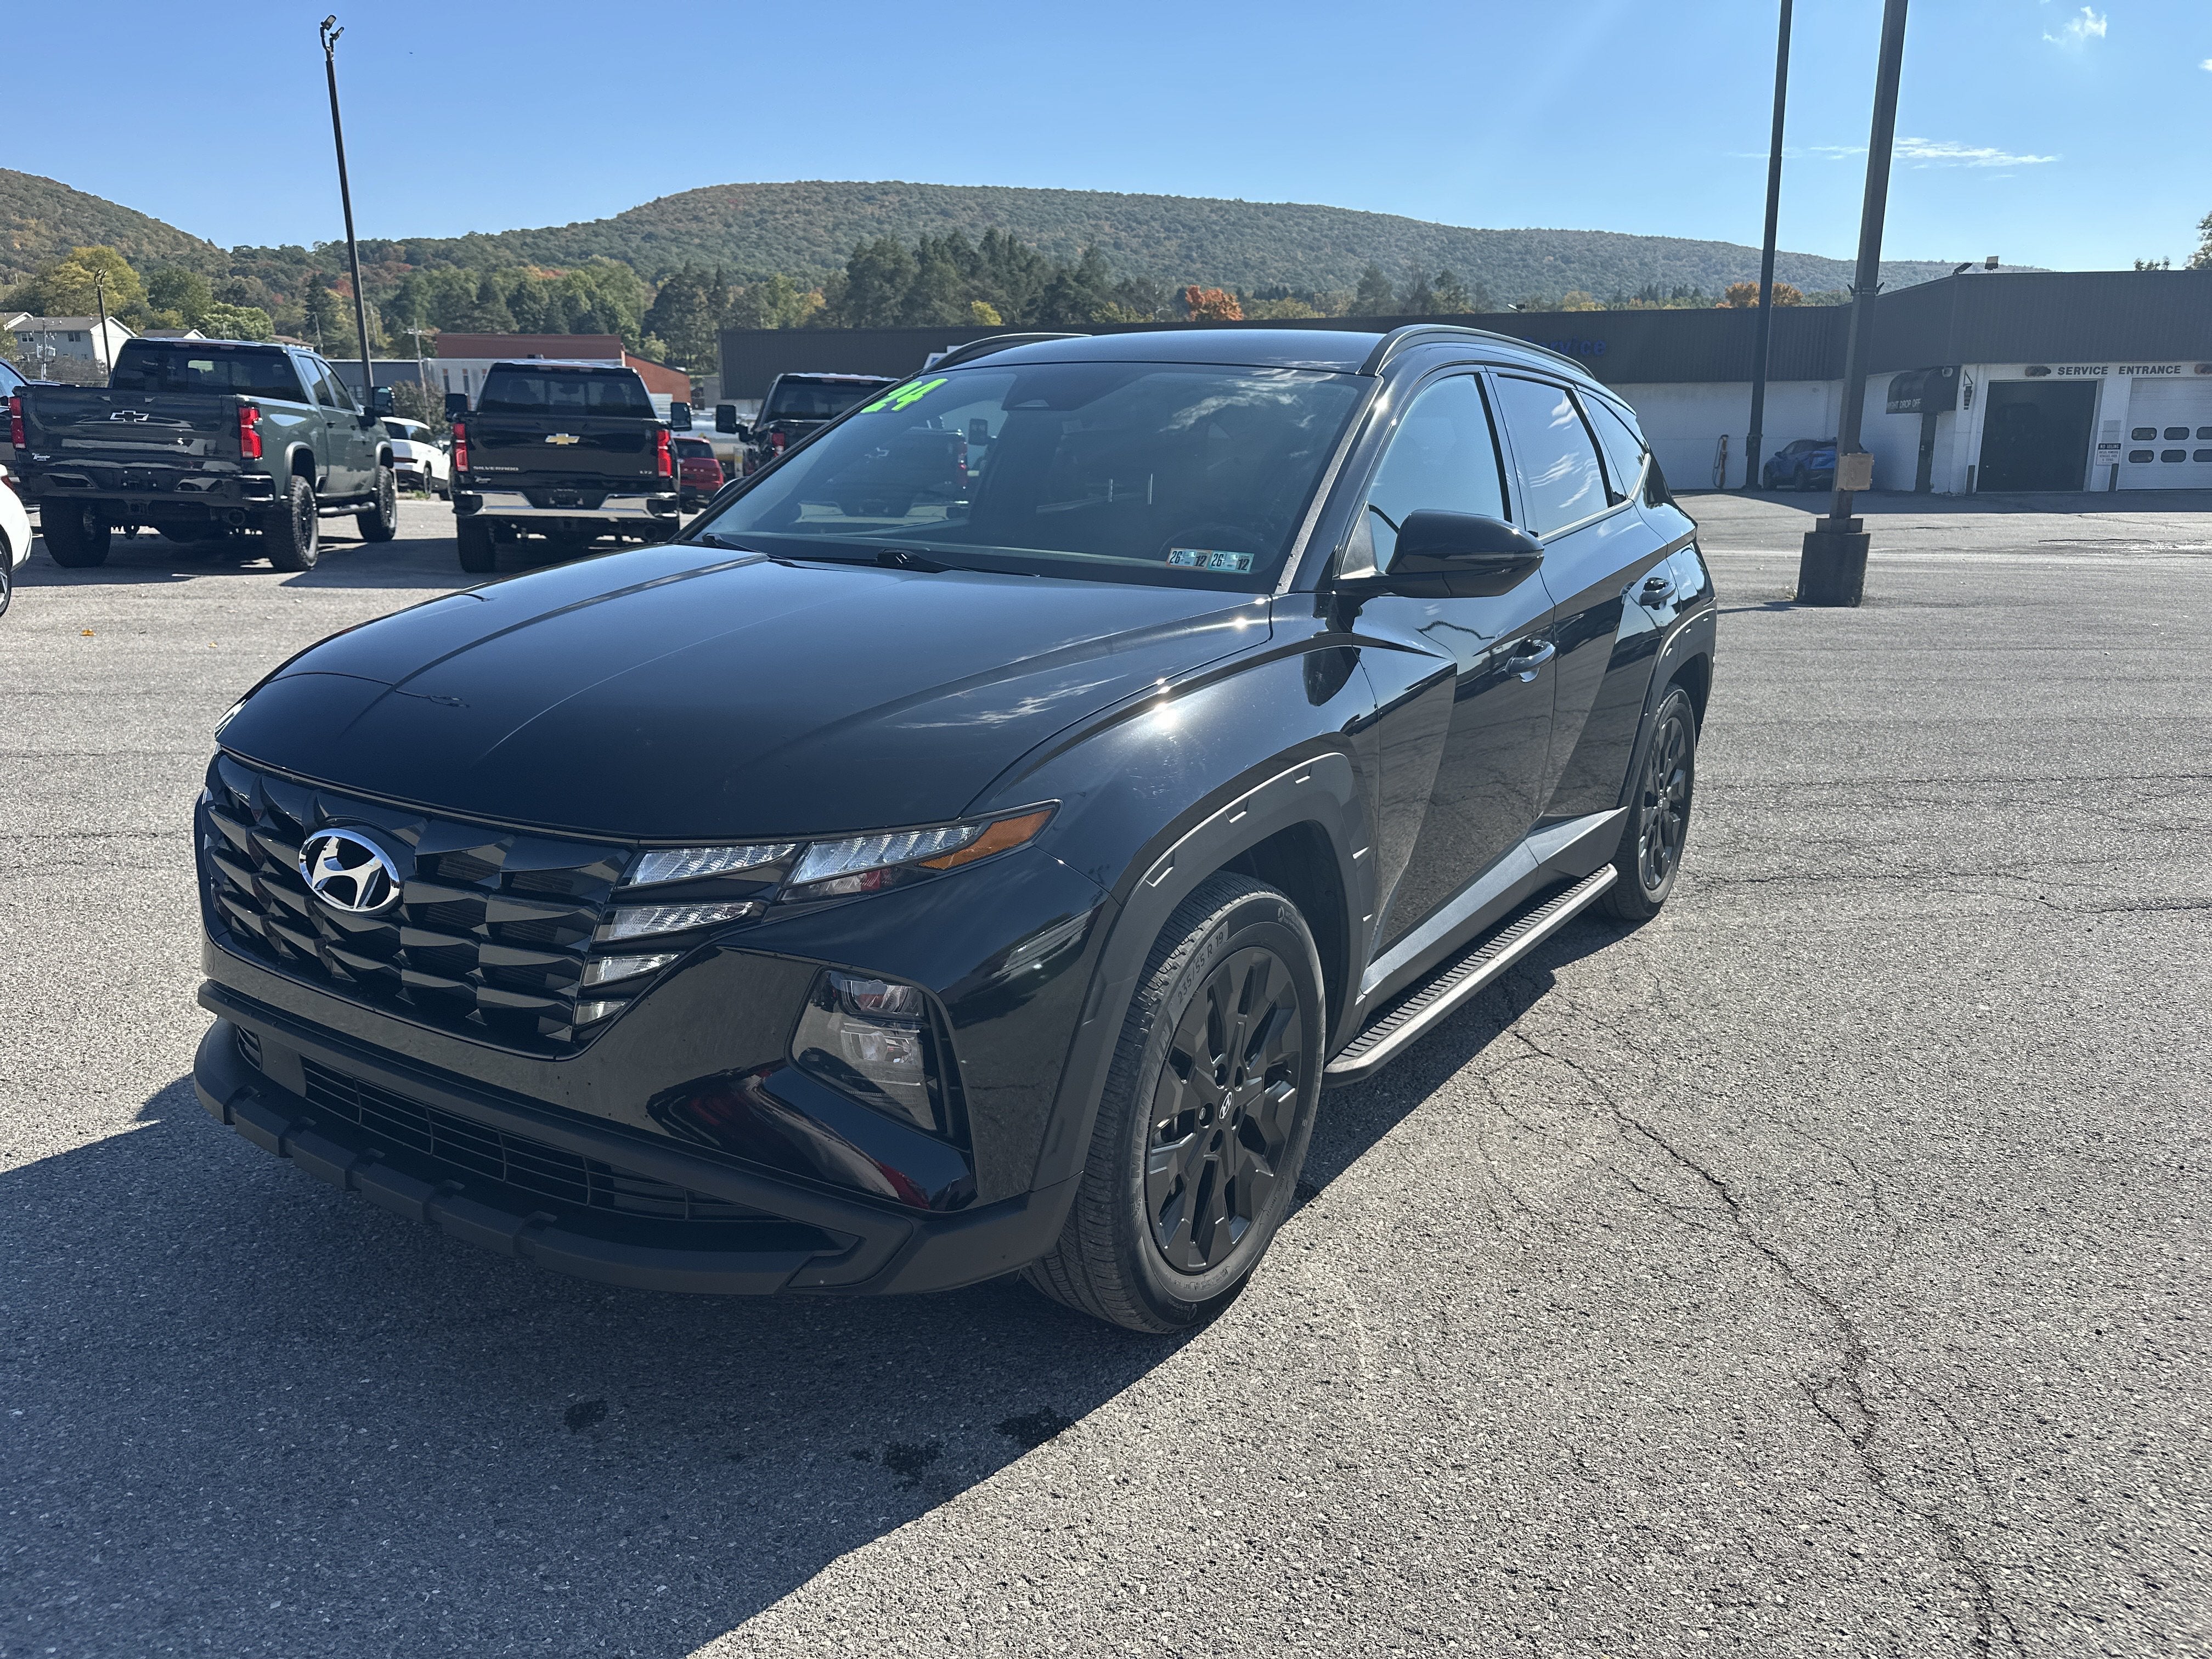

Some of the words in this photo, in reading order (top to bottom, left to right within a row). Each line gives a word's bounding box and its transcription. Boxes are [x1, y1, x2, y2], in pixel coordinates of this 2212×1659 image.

[2057, 366, 2108, 375] SERVICE
[2118, 365, 2181, 375] ENTRANCE
[860, 378, 949, 413] 24
[1899, 399, 1911, 409] DROP
[1912, 398, 1921, 408] OFF
[1169, 550, 1182, 564] 26
[1194, 555, 1207, 567] 12
[1211, 553, 1223, 567] 26
[1237, 558, 1250, 571] 12
[1177, 953, 1205, 1005] 235/55
[1207, 943, 1212, 958] R
[1215, 932, 1223, 947] 19
[1131, 1022, 1171, 1179] MICHELIN
